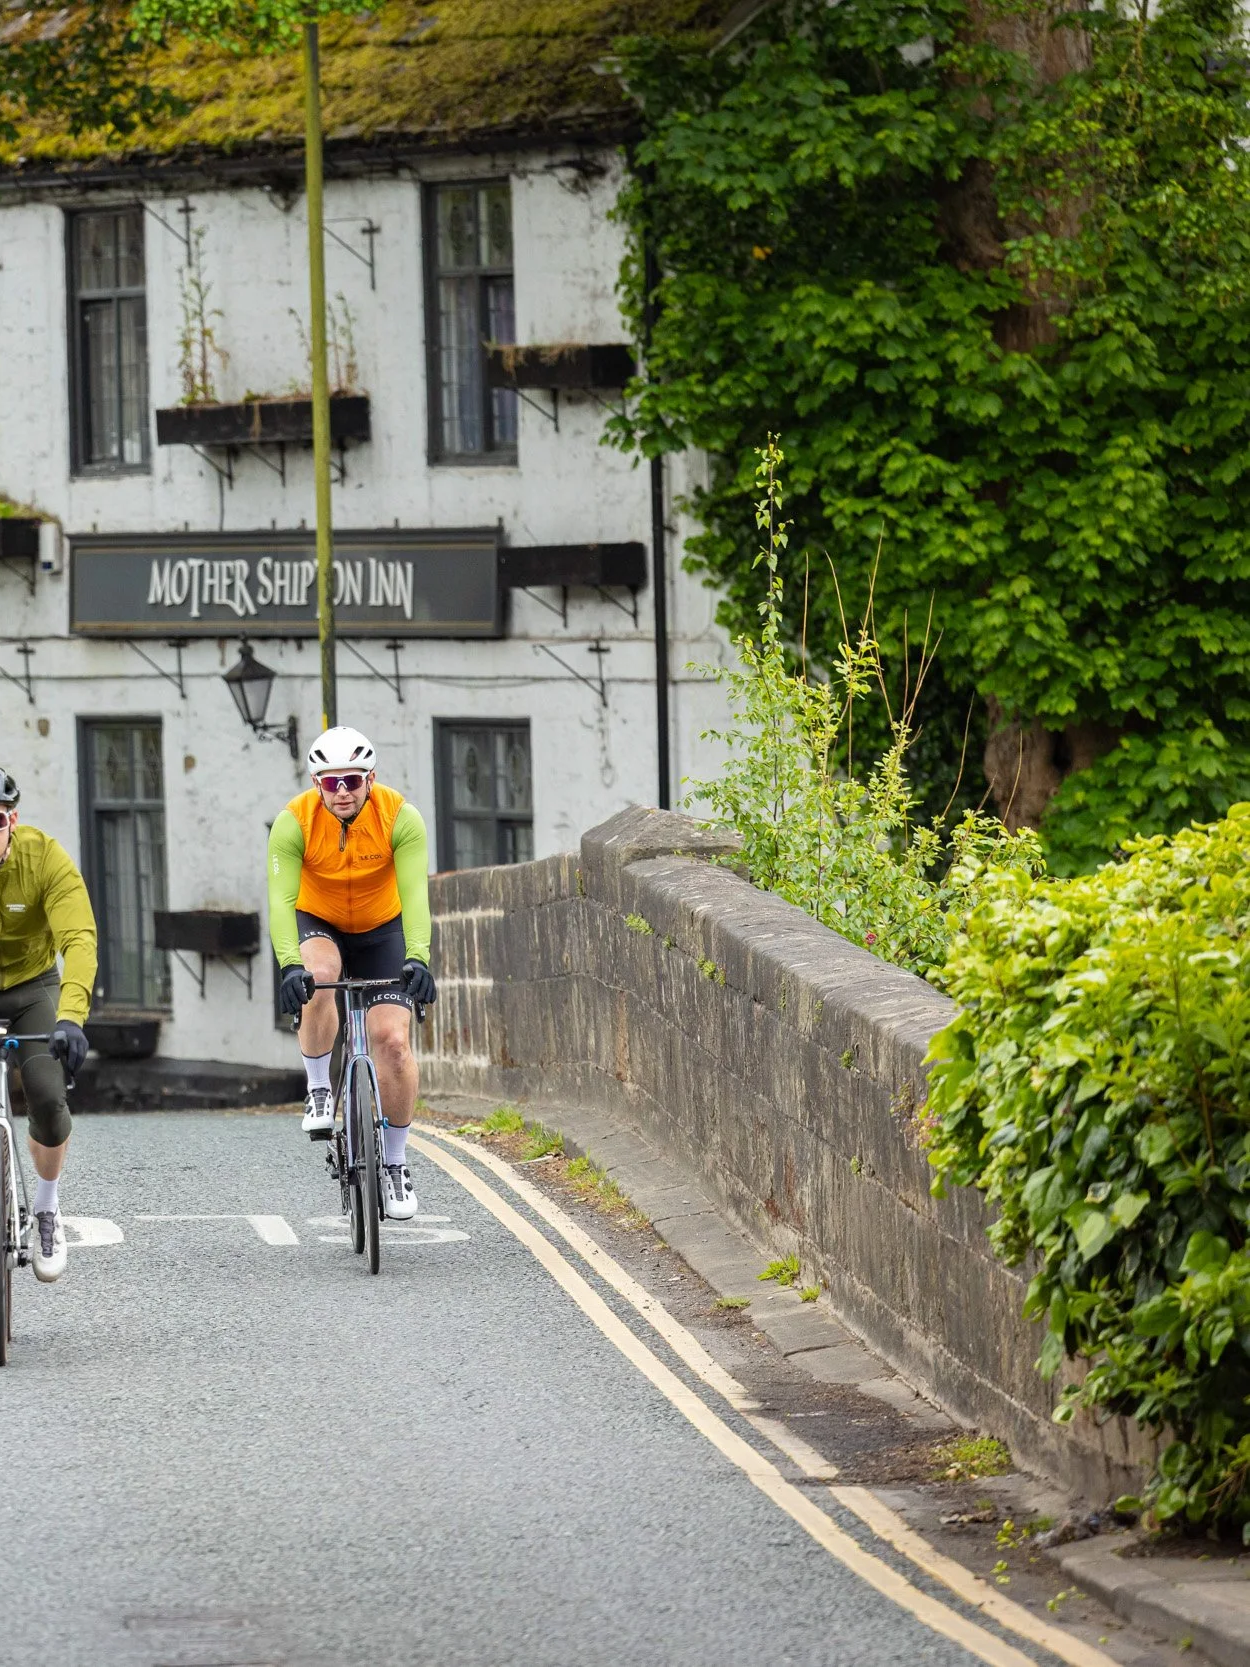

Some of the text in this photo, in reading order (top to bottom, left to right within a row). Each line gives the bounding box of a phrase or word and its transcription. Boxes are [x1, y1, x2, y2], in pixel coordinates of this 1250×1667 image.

[147, 556, 414, 619] MOTHER SHIPON INN
[373, 993, 402, 1002] LE COL
